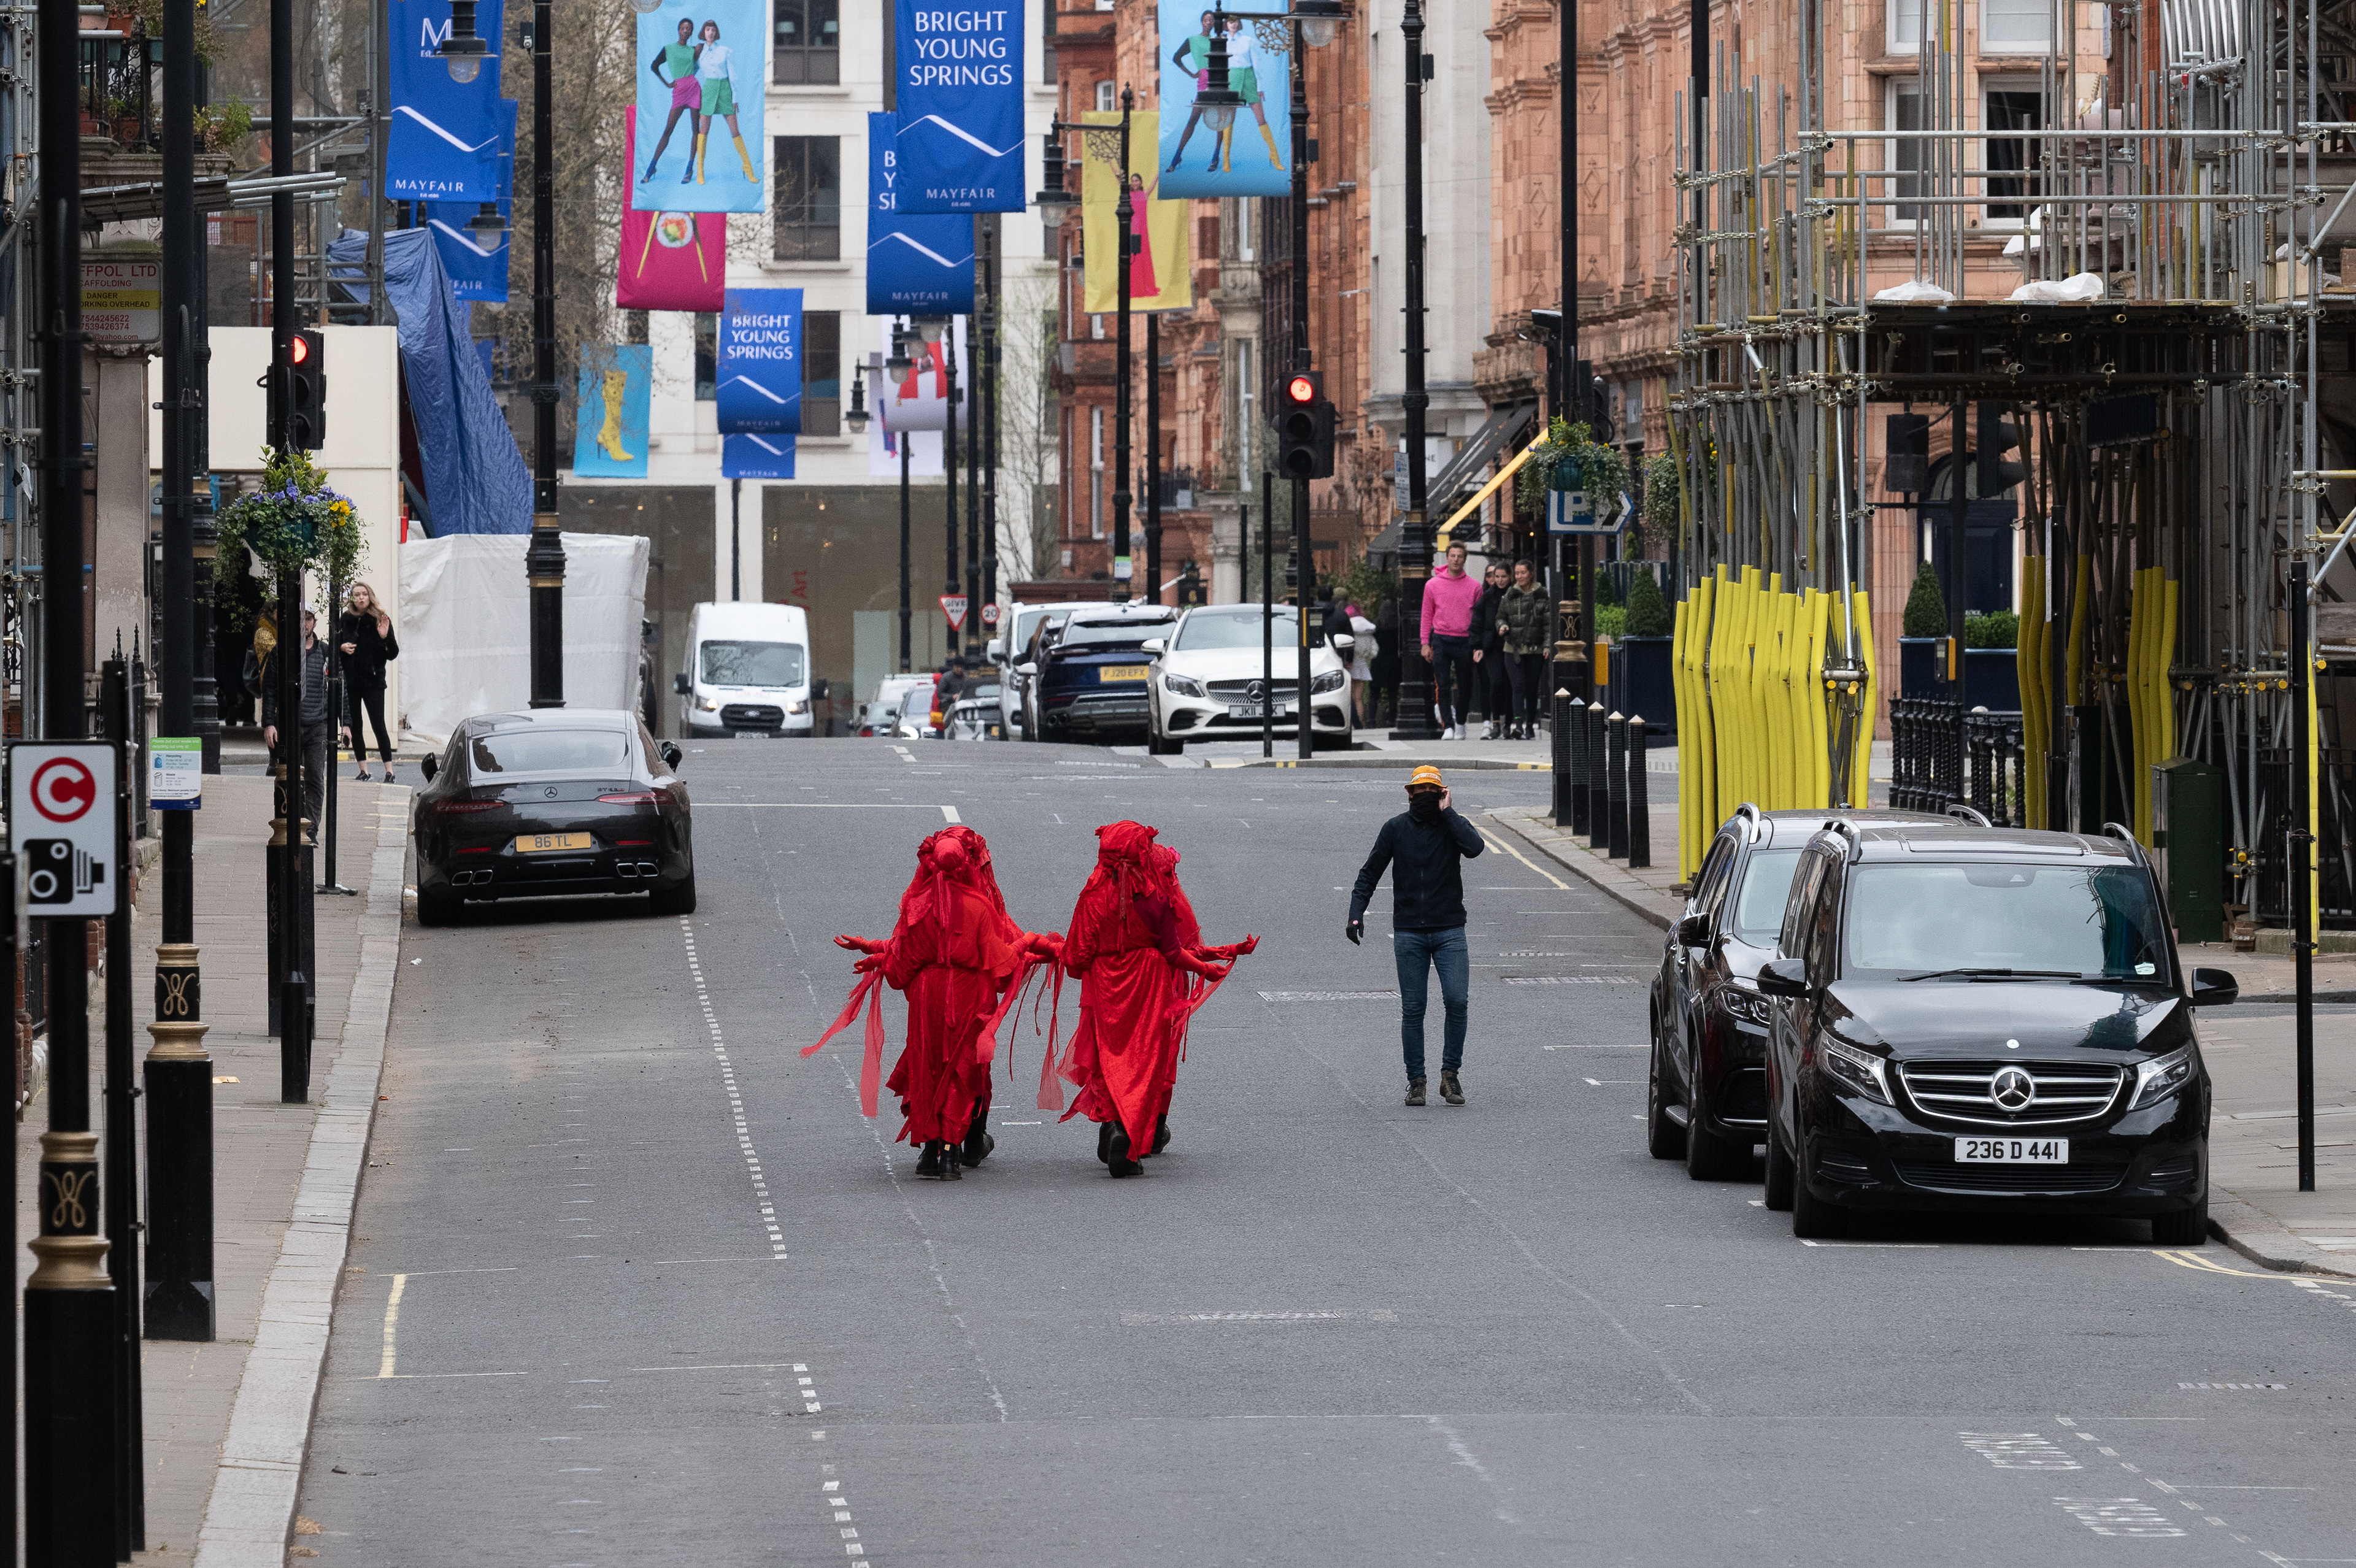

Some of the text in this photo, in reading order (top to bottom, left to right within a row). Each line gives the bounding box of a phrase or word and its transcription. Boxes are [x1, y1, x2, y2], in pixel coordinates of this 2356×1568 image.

[915, 10, 1007, 32] BRIGHT
[914, 37, 1006, 59] YOUNG
[909, 64, 1012, 86] SPRINGS
[395, 179, 463, 192] MAYFAIR
[926, 188, 995, 199] MAYFAIR
[80, 266, 156, 277] FFPOL LTD
[451, 280, 483, 290] FAIR
[891, 291, 949, 301] MAYFAIR
[732, 314, 791, 328] BRIGHT
[731, 329, 790, 344] YOUNG
[727, 345, 793, 360] SPRINGS
[1564, 491, 1590, 522] P
[984, 609, 997, 618] 20
[534, 835, 572, 848] 86 TL
[1966, 1140, 2058, 1159] 236 D 441
